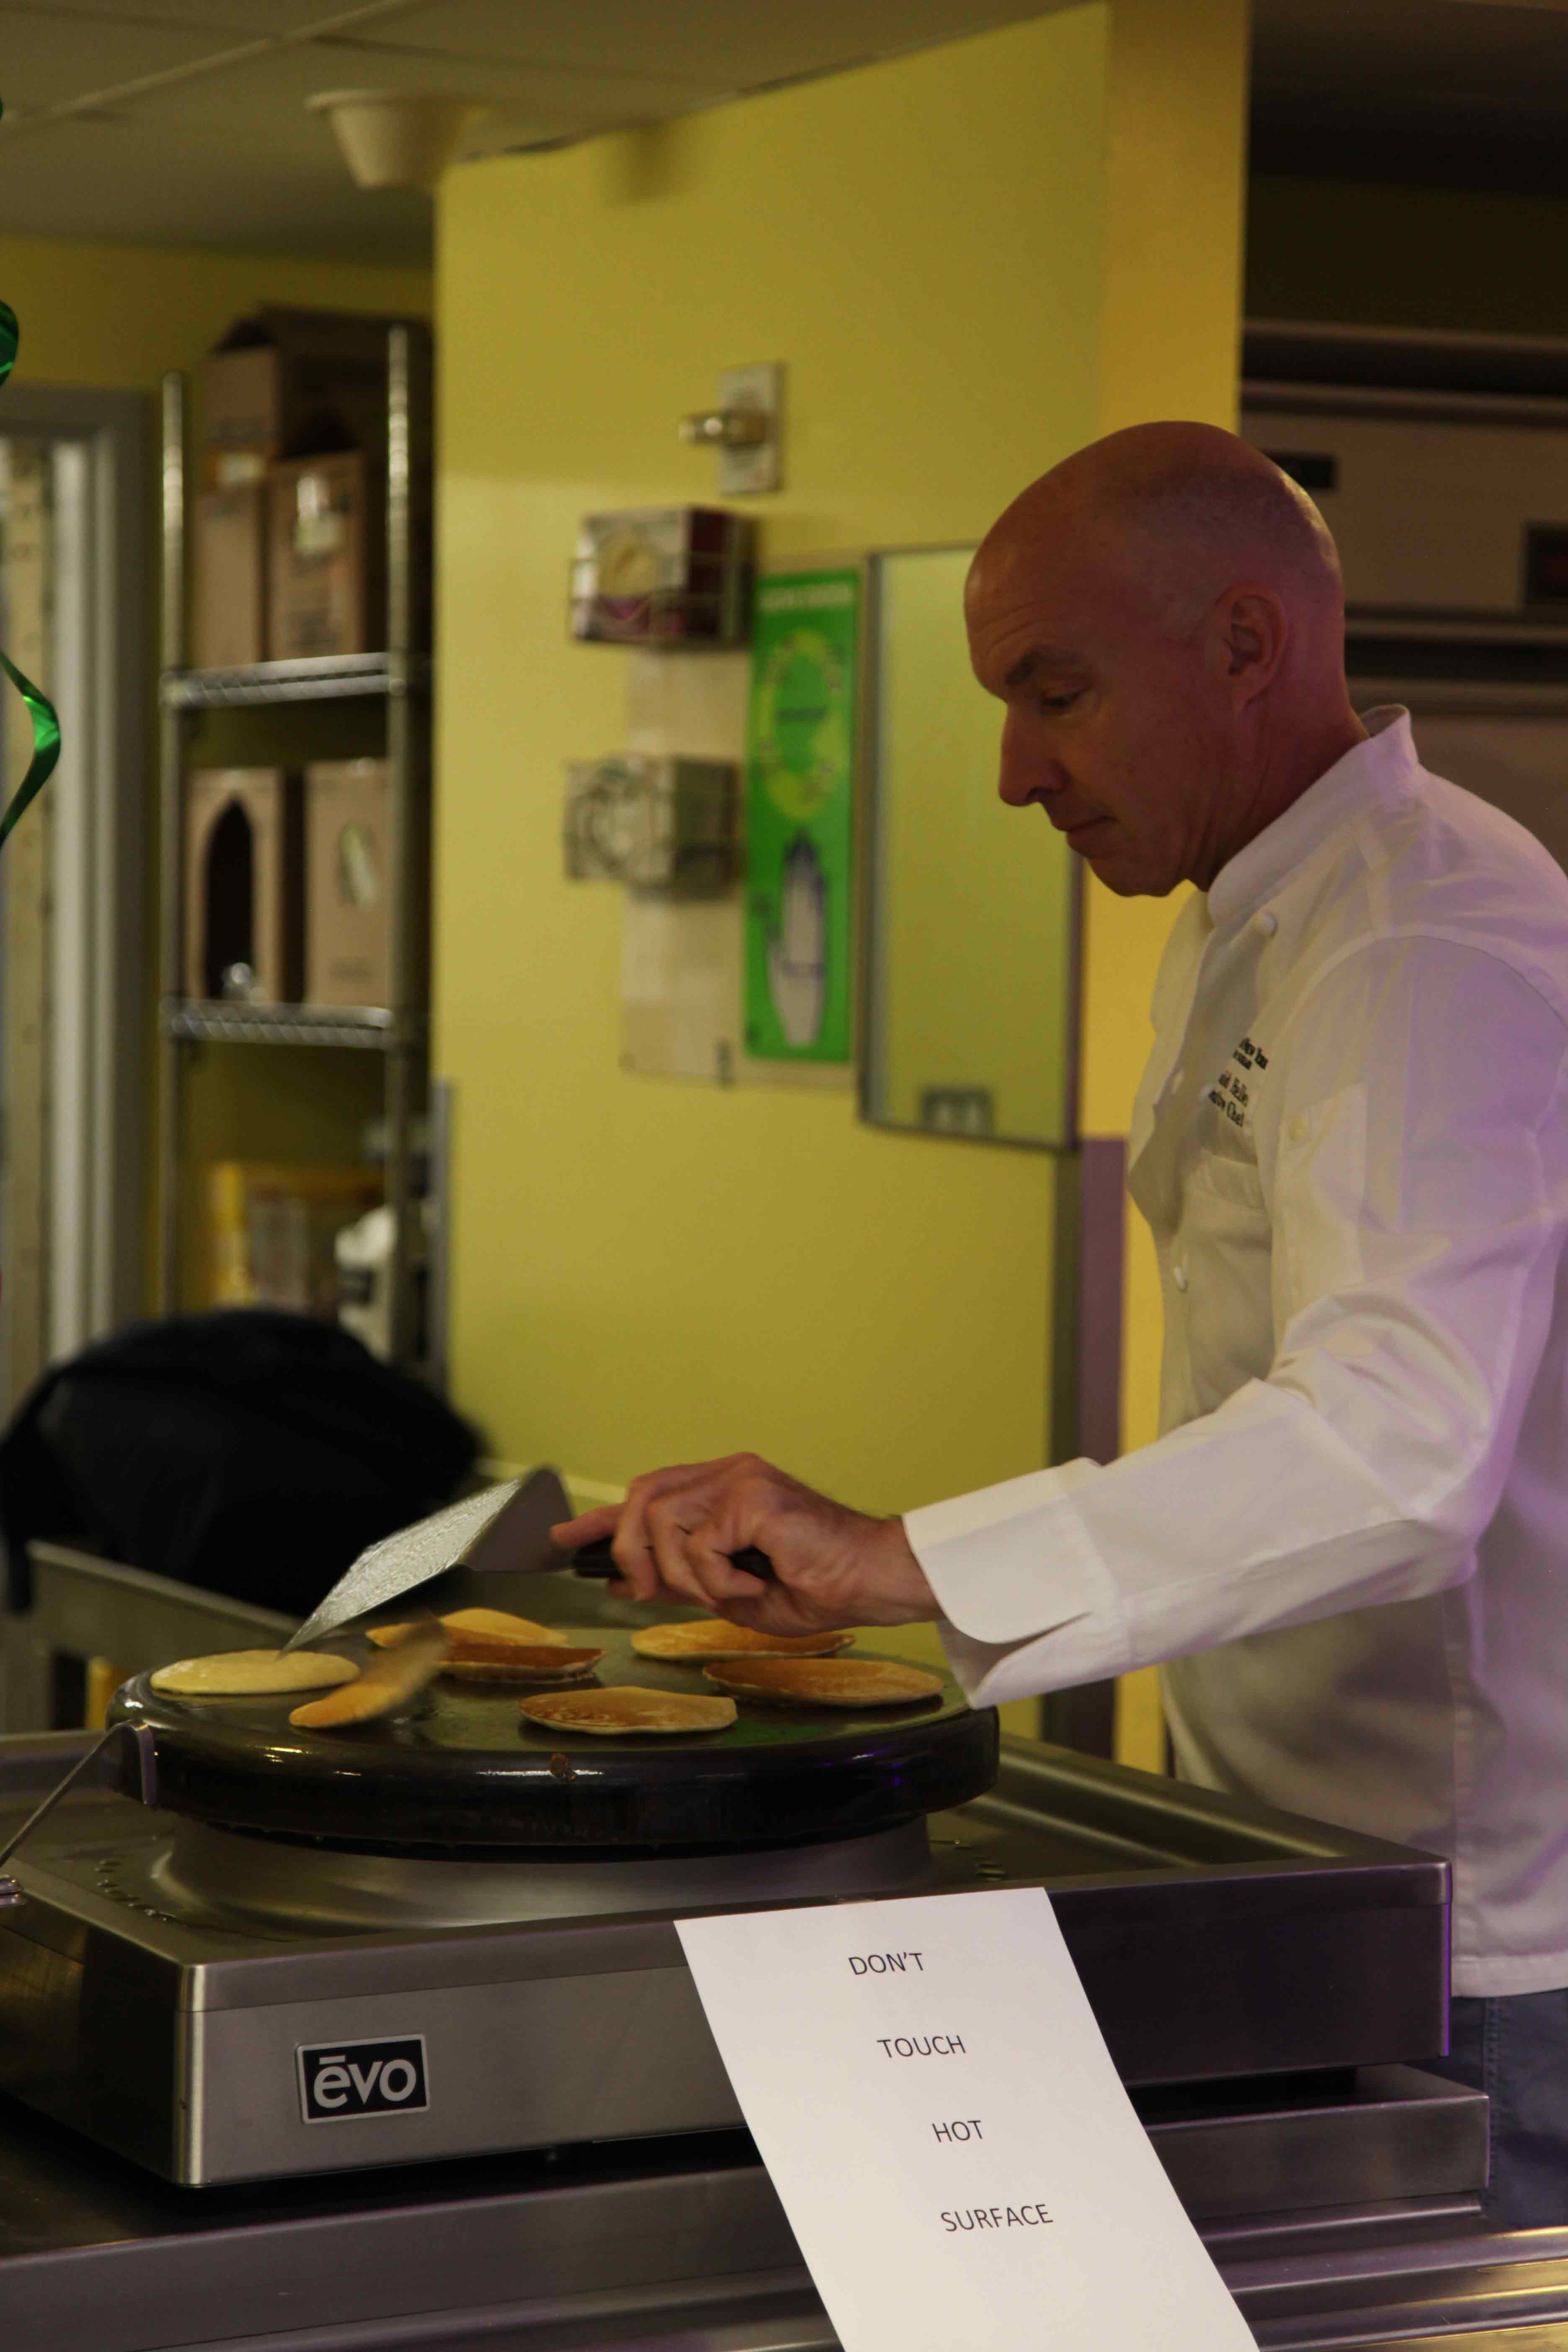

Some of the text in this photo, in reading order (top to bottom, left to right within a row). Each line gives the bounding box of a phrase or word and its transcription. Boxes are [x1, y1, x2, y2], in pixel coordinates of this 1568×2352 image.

[848, 1952, 924, 1975] DON'T
[877, 2035, 966, 2058] TOUCH
[931, 2120, 983, 2143] HOT
[940, 2204, 1054, 2232] SURFACE
